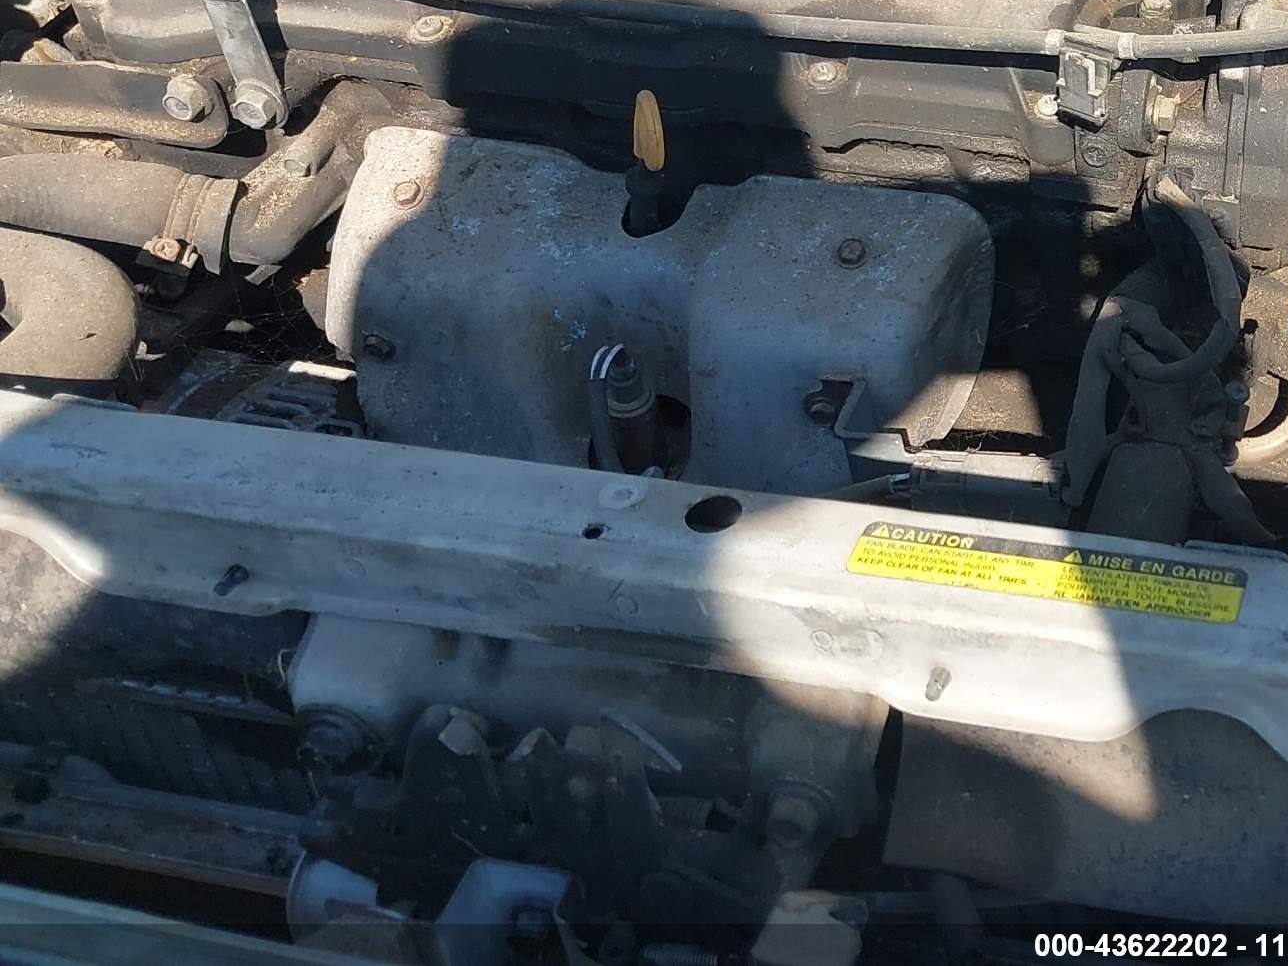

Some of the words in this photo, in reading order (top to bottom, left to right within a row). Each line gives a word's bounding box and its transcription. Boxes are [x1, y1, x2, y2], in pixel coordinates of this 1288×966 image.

[890, 528, 975, 549] CAUTION
[863, 547, 874, 556] TO
[877, 550, 906, 560] AVOID
[866, 540, 886, 549] FAN
[887, 543, 916, 553] BLADE
[921, 546, 940, 556] CAN
[857, 557, 881, 566] KEEP
[886, 560, 916, 571] CLEAR
[921, 564, 935, 573] OF
[938, 566, 958, 575] FAN
[960, 569, 973, 577] AT
[976, 571, 992, 581] ALL
[999, 575, 1027, 586] TIMES
[1088, 553, 1134, 571] MISE
[1140, 561, 1165, 574] EN
[1172, 565, 1237, 584] GARDE
[1057, 582, 1087, 593] POUR
[1167, 588, 1213, 601] MOMENT
[1072, 592, 1111, 604] JAMAIS
[1144, 602, 1211, 618] APPROCHER
